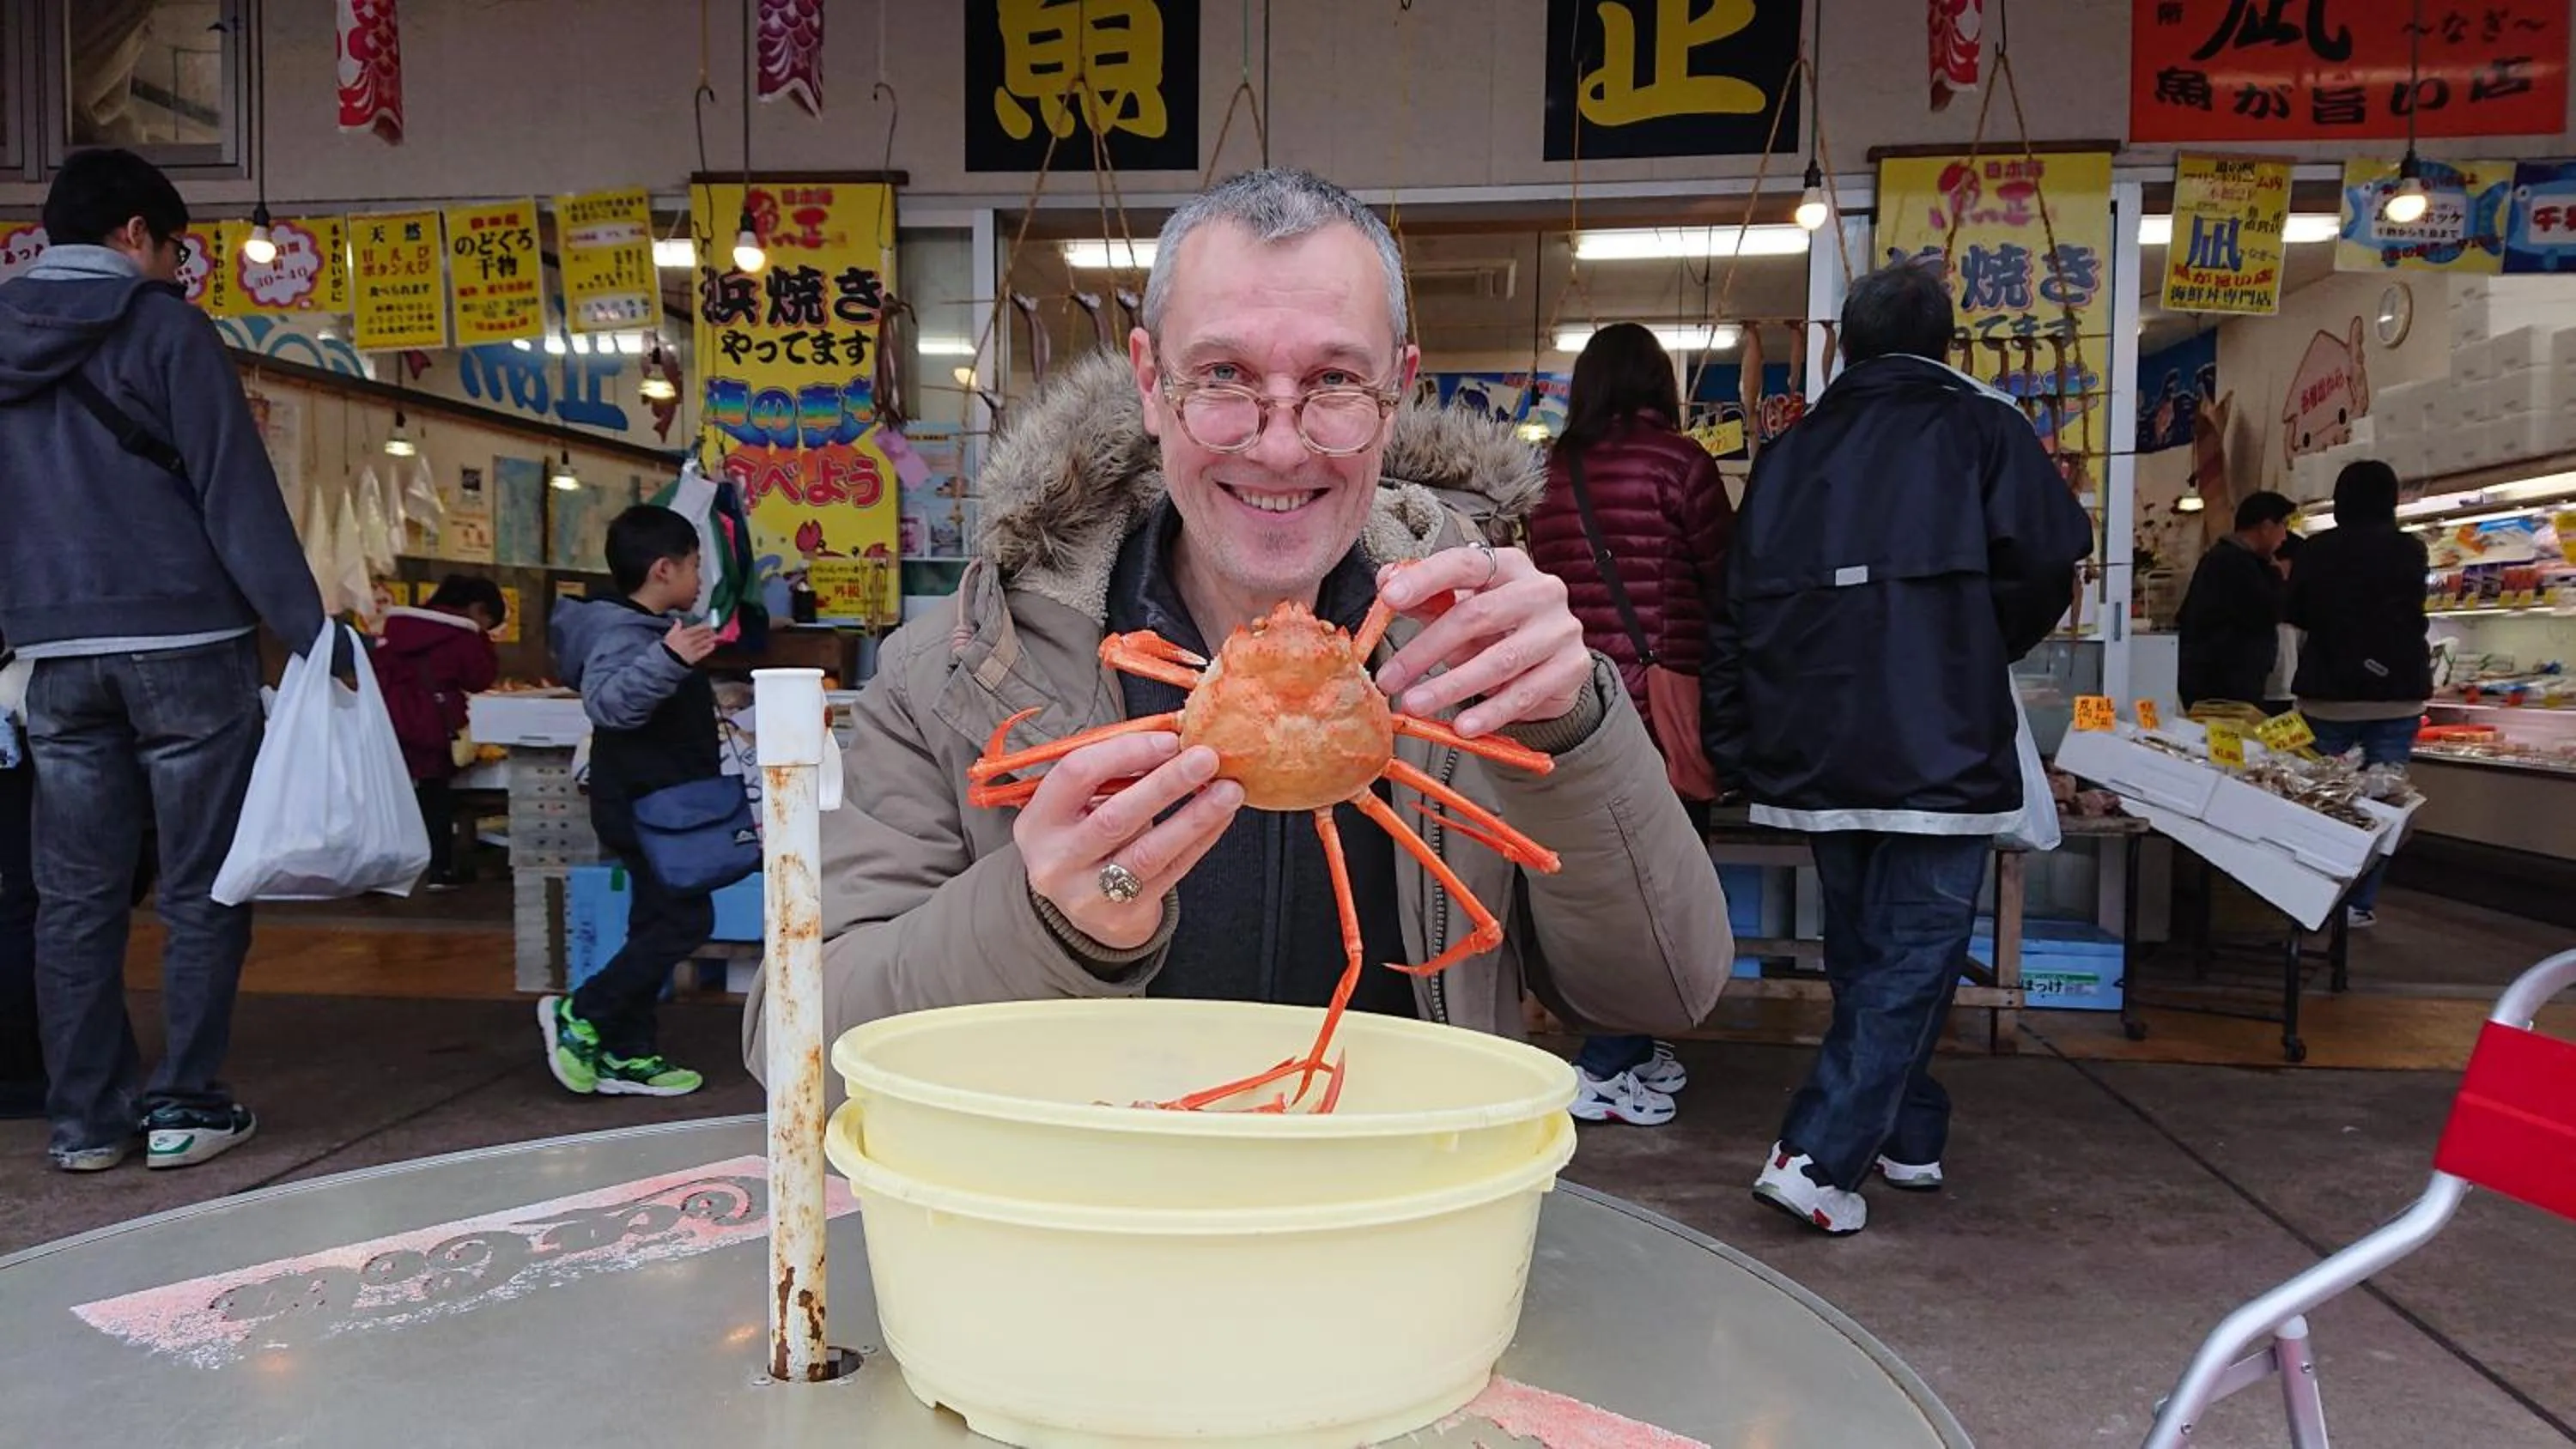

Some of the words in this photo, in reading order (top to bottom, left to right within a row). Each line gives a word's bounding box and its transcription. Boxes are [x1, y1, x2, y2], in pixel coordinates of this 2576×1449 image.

[993, 0, 1169, 141] 魚
[1577, 0, 1767, 127] 正
[2154, 56, 2536, 124] 魚が旨い店
[454, 227, 533, 256] のどぐろ
[2186, 215, 2242, 272] 凪
[698, 264, 884, 329] 浜焼き
[720, 329, 872, 367] やってます
